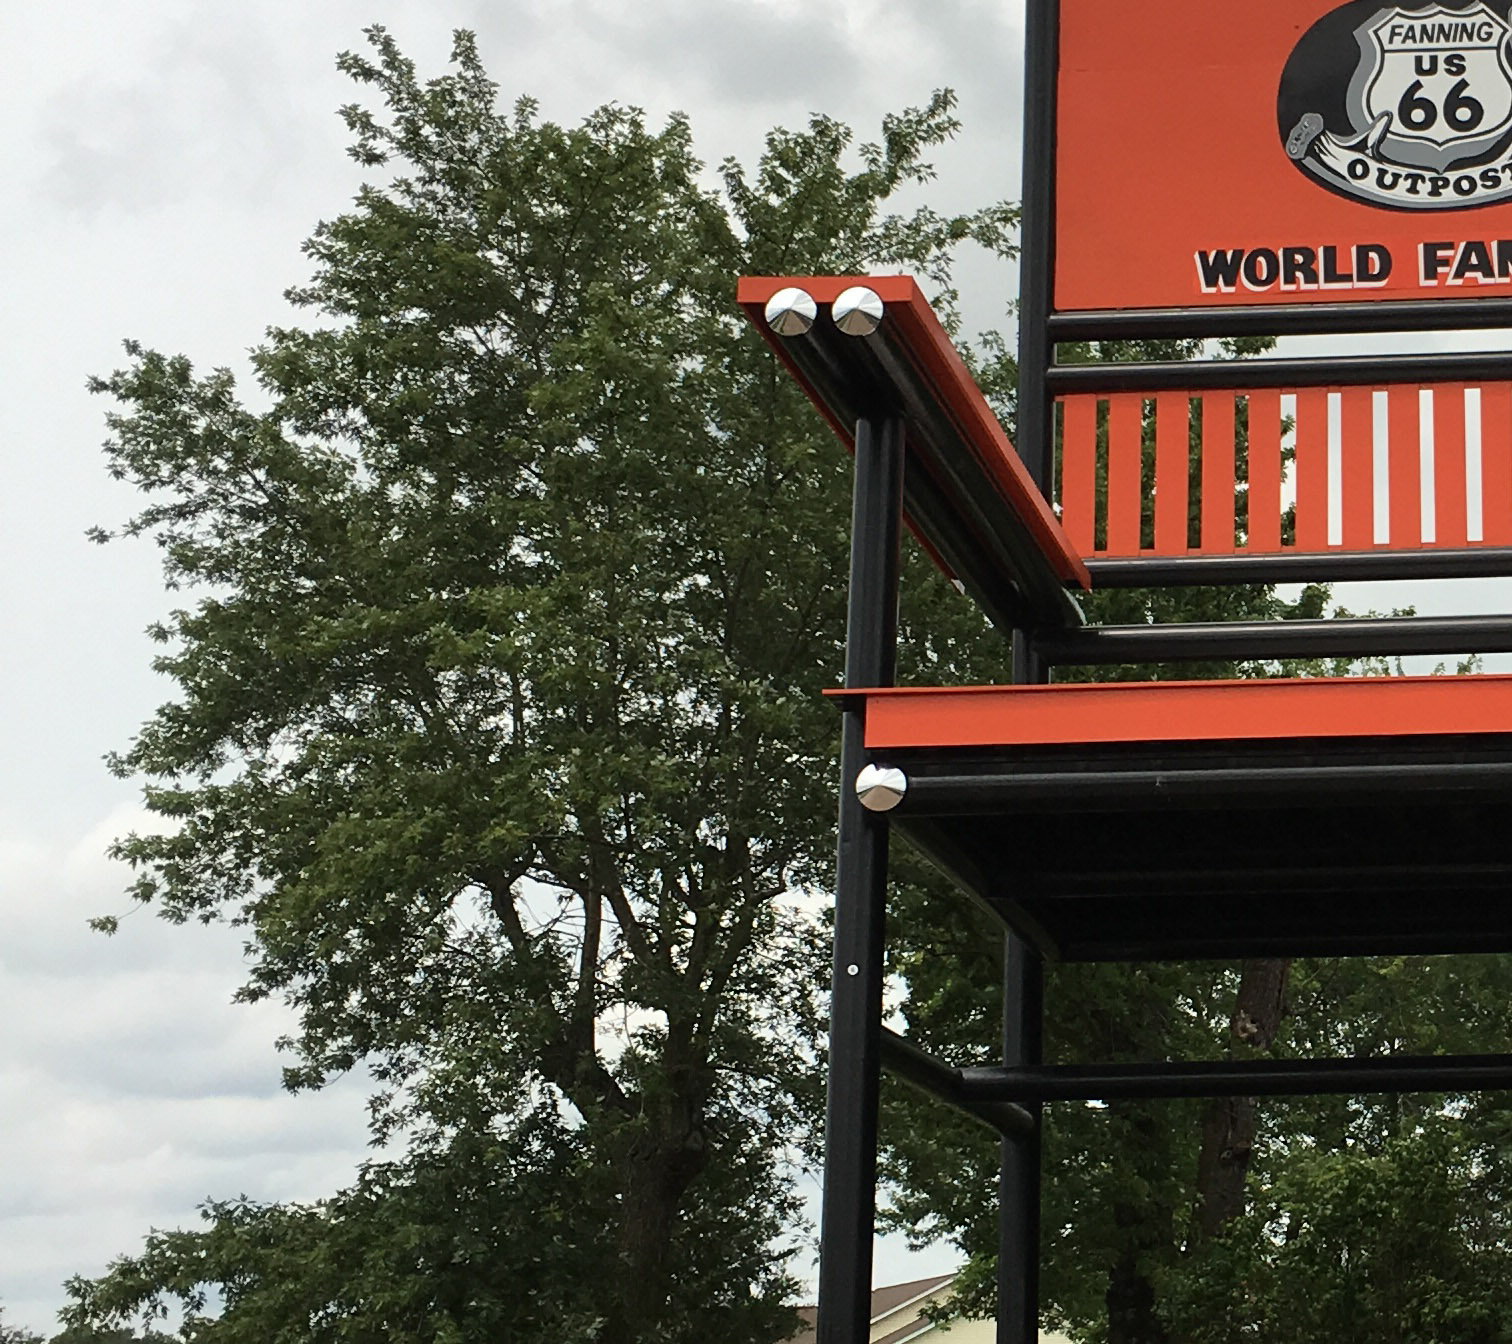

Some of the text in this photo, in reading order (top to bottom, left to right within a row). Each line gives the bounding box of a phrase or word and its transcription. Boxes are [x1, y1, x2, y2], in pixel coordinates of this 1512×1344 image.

[1387, 19, 1495, 47] FANNING
[1413, 54, 1467, 77] US
[1397, 80, 1484, 132] 66
[1194, 243, 1393, 294] WORLD
